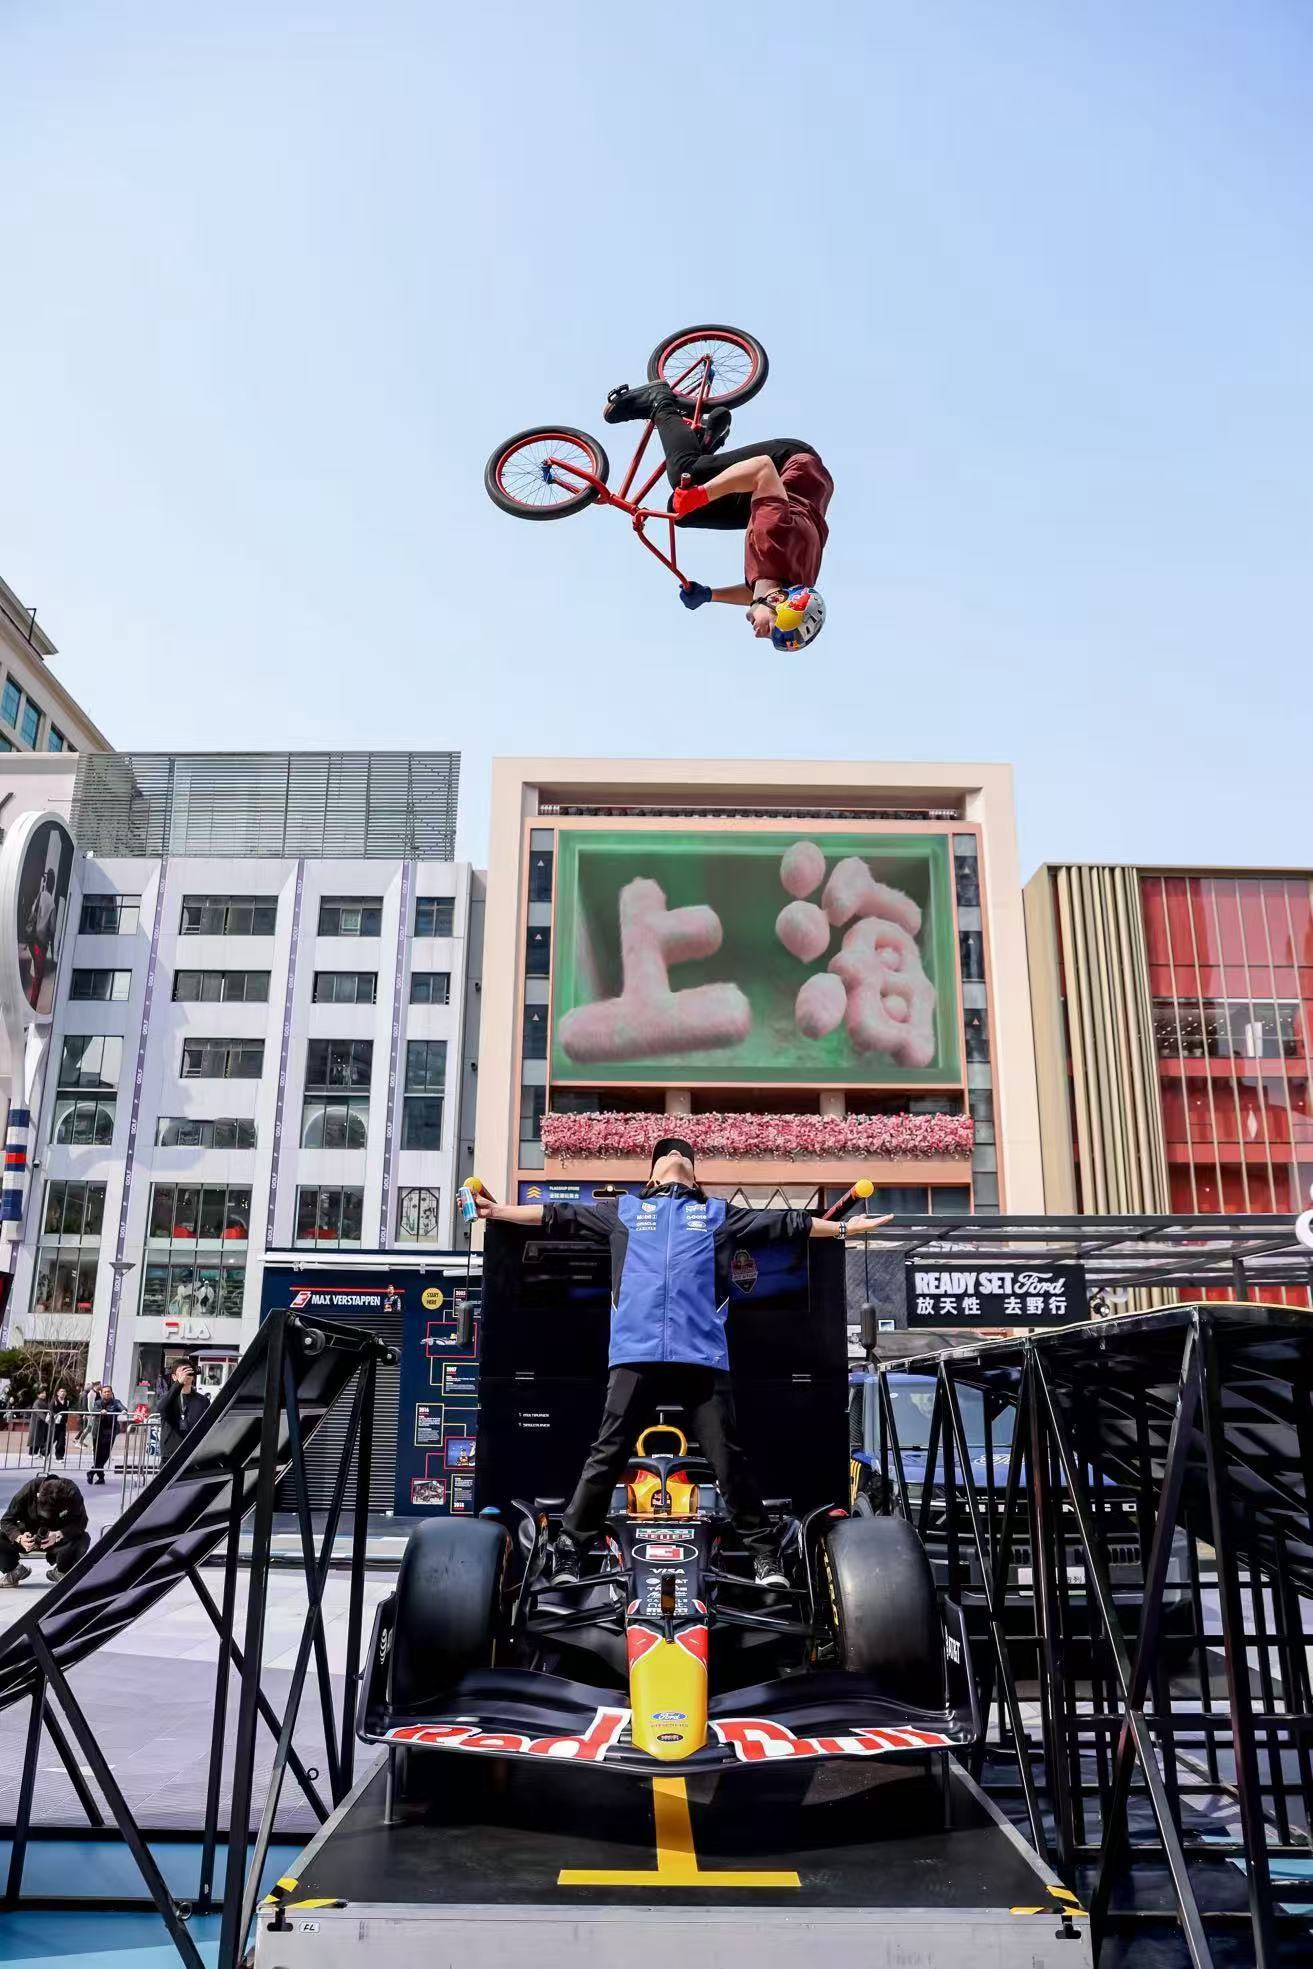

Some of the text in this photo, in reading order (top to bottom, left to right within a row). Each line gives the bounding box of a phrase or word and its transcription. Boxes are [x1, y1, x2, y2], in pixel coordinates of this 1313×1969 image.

[558, 841, 935, 1069] 上海
[914, 1272, 1066, 1294] READY SET Ford
[311, 1294, 331, 1305] MAX
[332, 1294, 381, 1306] VERSTAPPEN
[916, 1296, 1067, 1315] 放天性 去野行
[165, 1321, 211, 1340] FILA
[387, 1706, 952, 1762] Red Bull
